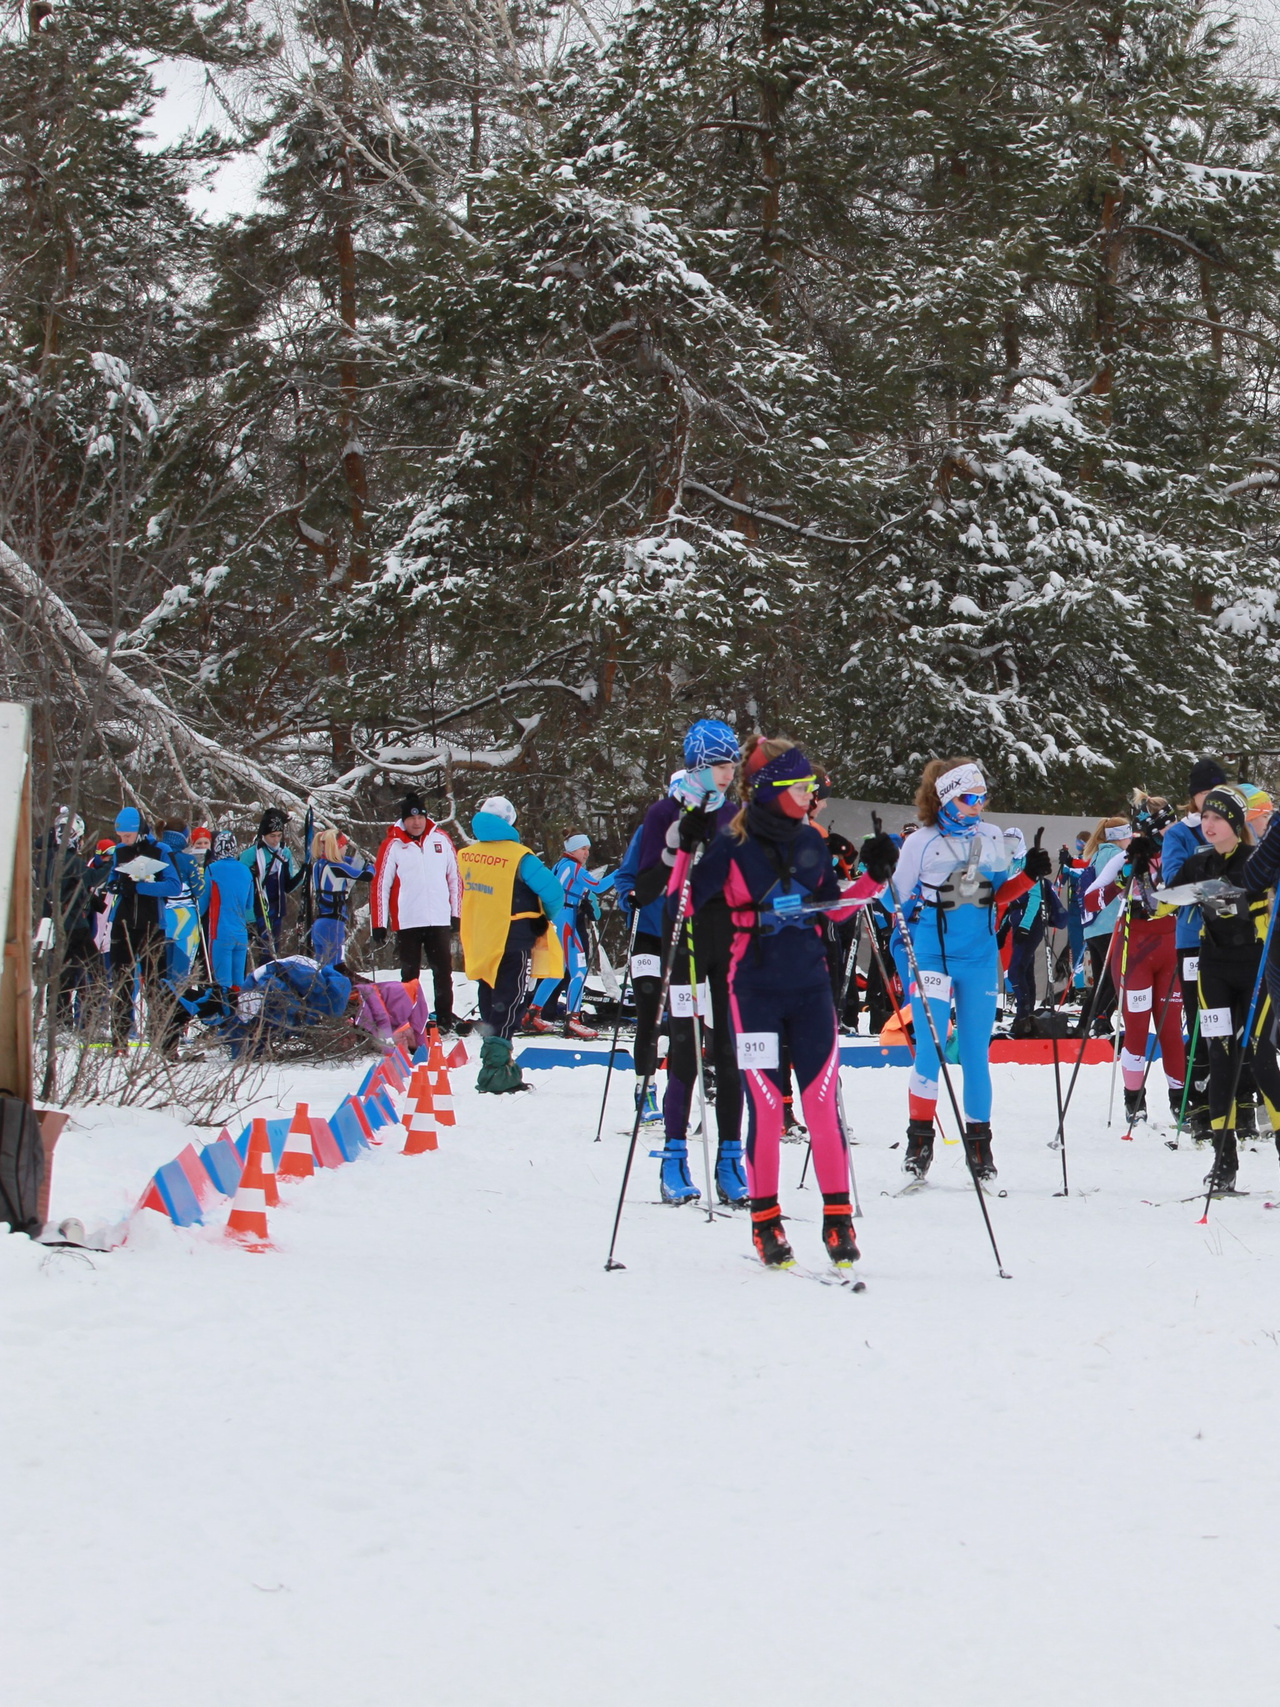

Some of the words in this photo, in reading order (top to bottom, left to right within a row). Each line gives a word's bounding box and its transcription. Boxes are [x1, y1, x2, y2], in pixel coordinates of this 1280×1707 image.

[940, 778, 962, 798] swix
[461, 852, 509, 868] РОССПОРТ
[924, 976, 942, 986] 929
[1133, 995, 1147, 1003] 968
[1203, 1014, 1219, 1023] 919
[744, 1042, 766, 1052] 910
